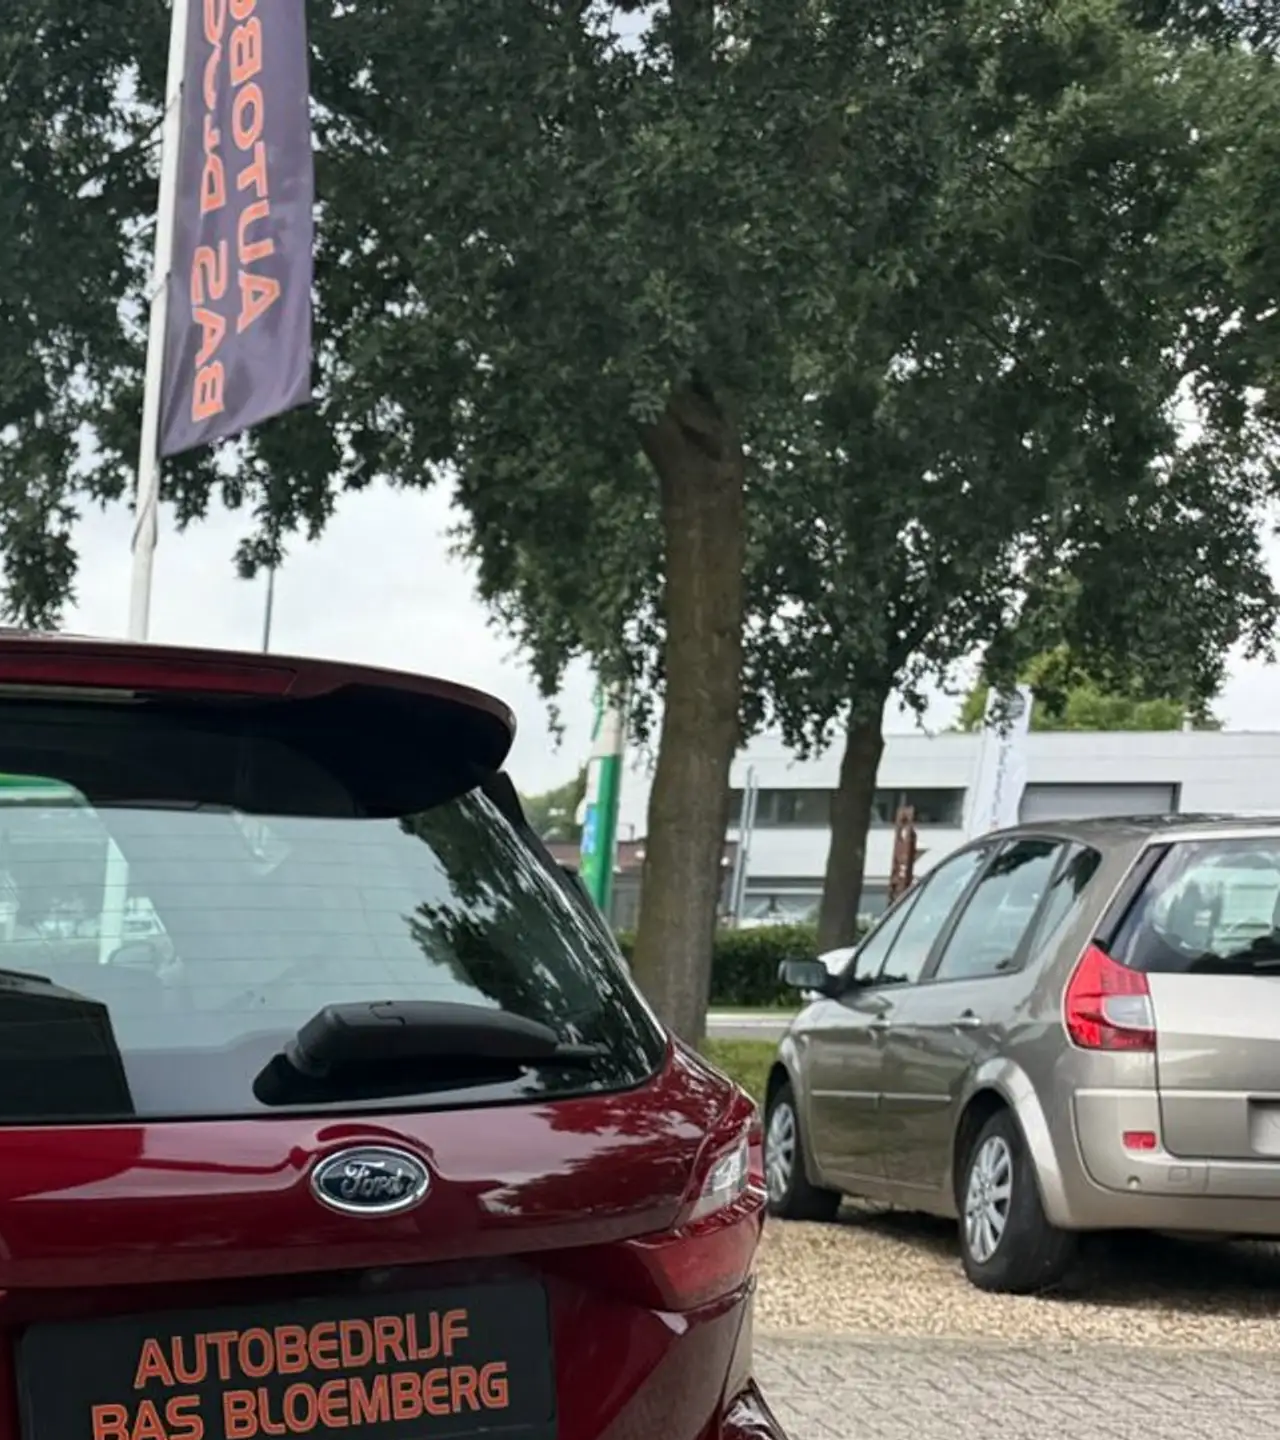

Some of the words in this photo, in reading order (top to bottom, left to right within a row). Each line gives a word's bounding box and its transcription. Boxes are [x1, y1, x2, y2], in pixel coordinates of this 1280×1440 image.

[341, 1161, 415, 1199] Ford
[134, 1309, 469, 1389] AUTOBEDRIJF
[223, 1362, 509, 1440] BLOEMBERG
